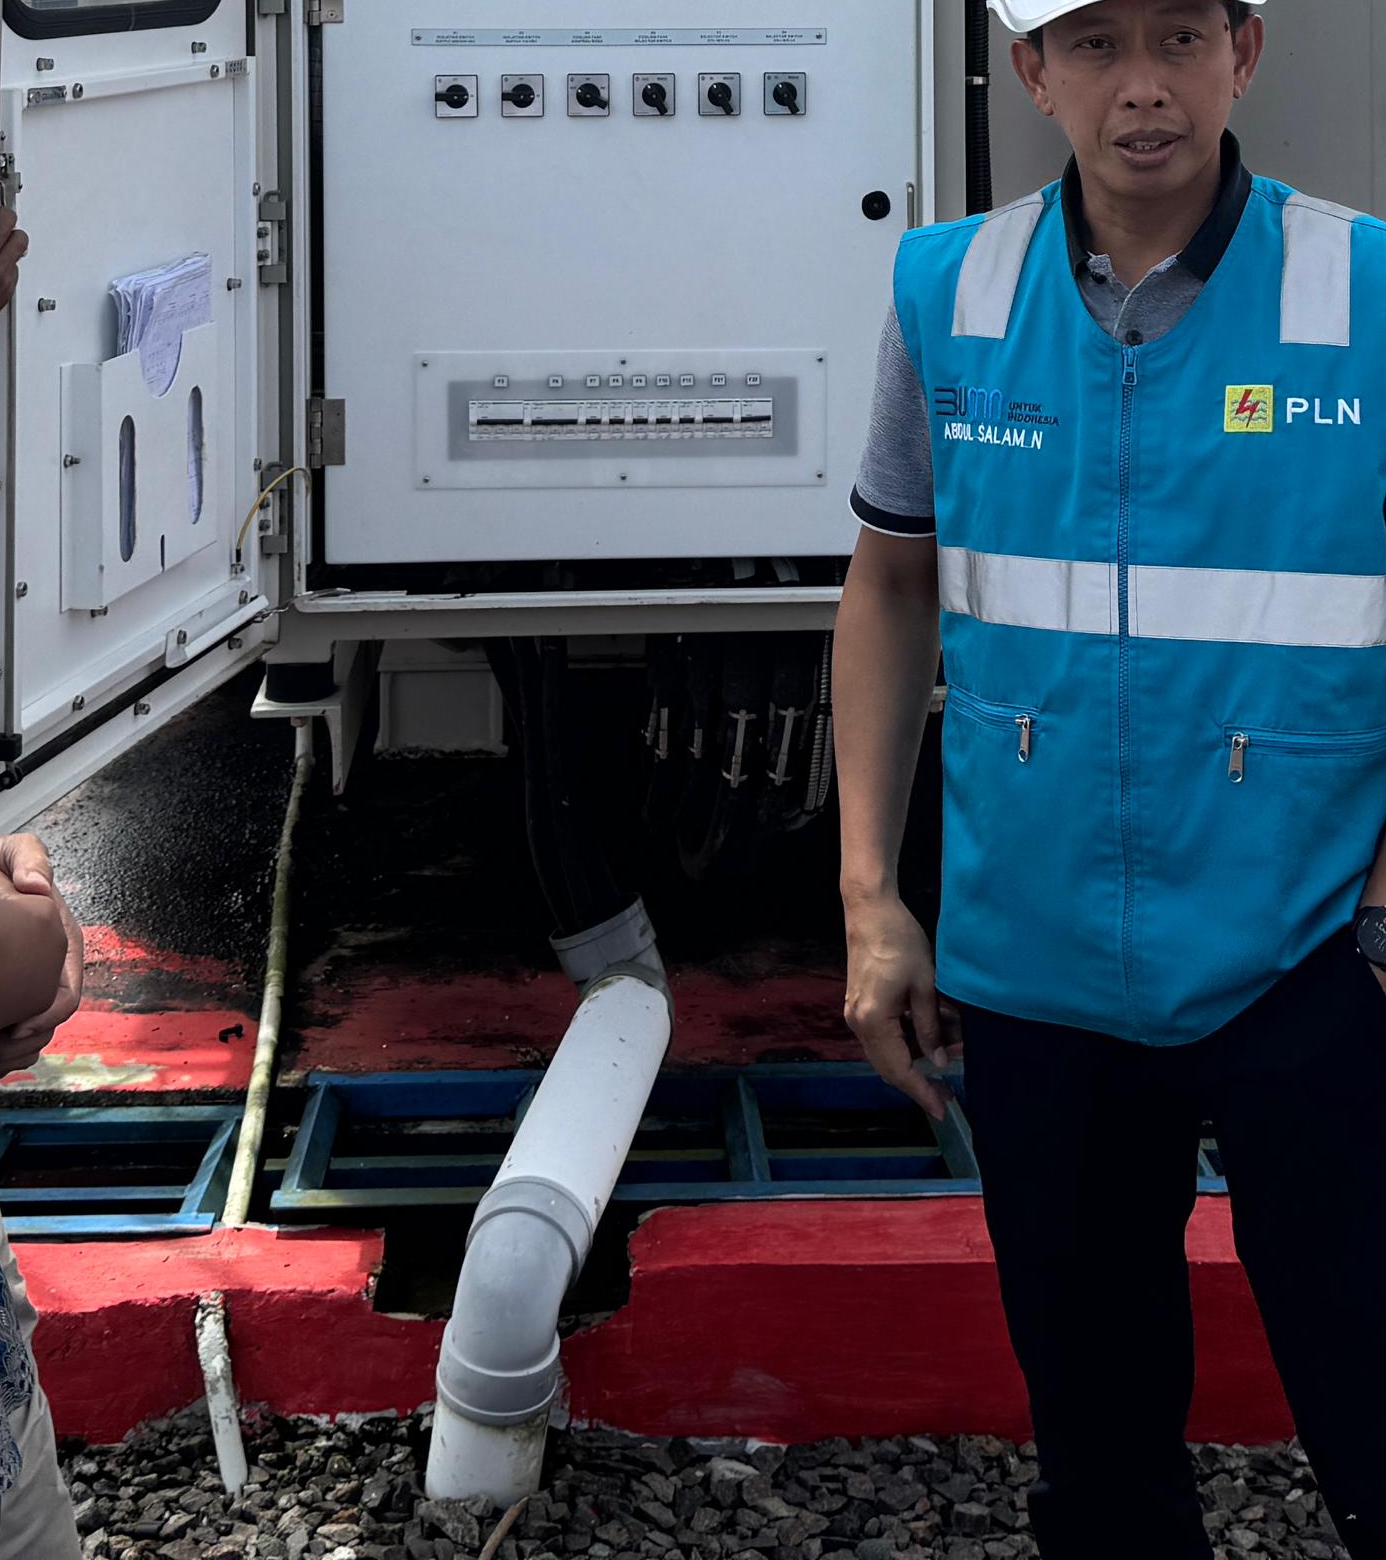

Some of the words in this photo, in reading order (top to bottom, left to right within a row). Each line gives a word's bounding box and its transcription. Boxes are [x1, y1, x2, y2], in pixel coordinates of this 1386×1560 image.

[1009, 401, 1043, 413] UNTUK
[1286, 397, 1361, 425] PLN
[1007, 412, 1060, 426] INDONESIA
[944, 422, 974, 441] ABDUL
[978, 424, 1026, 448] SALAM
[1031, 430, 1044, 450] N
